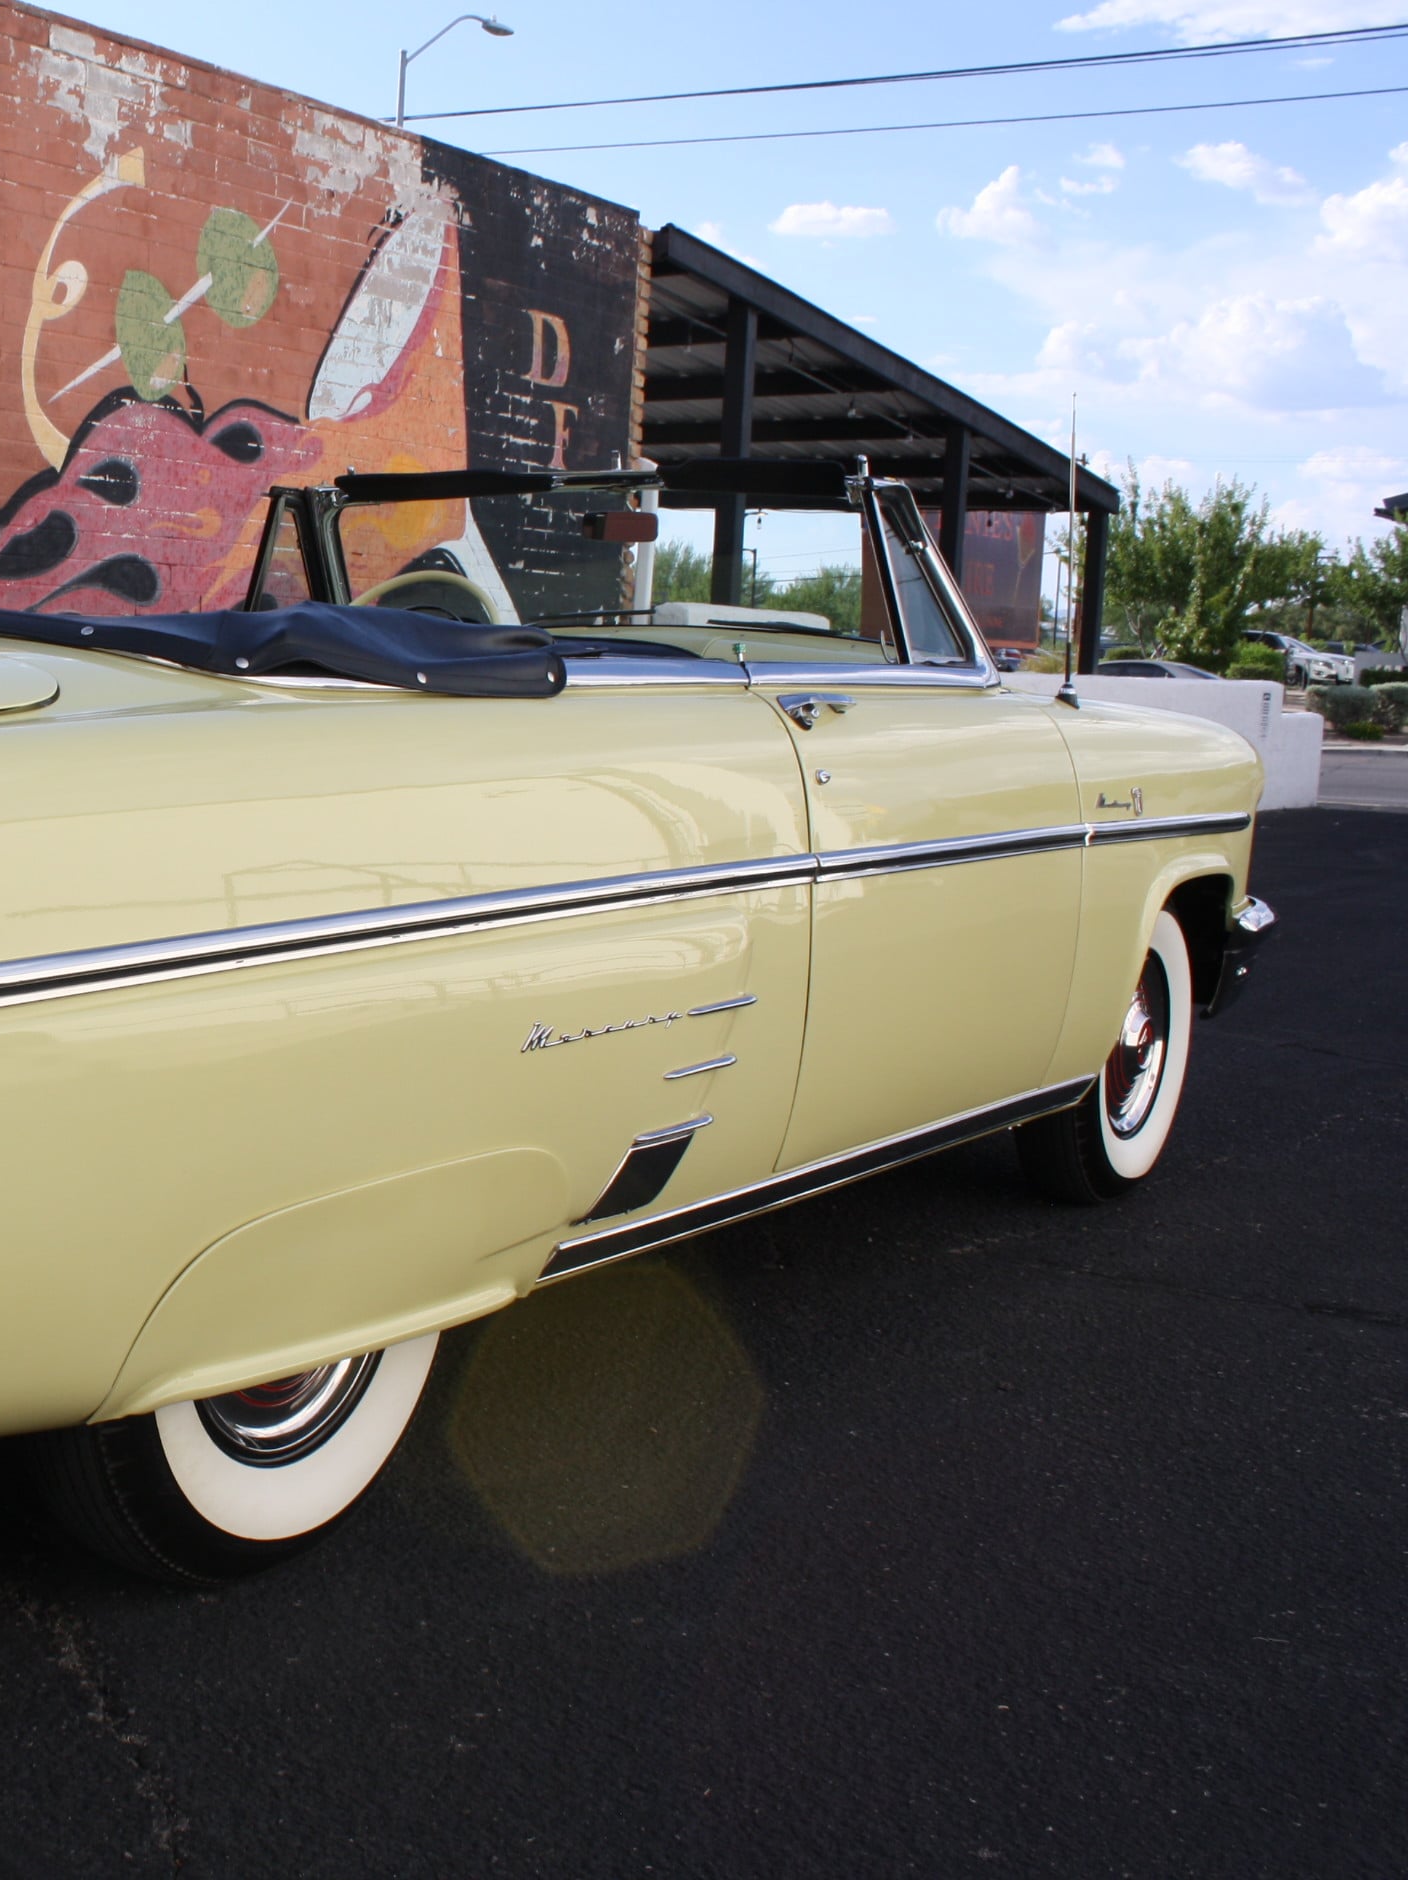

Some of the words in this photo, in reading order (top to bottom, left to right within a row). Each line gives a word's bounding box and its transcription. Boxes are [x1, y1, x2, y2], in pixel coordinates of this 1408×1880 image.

[520, 309, 572, 388] D
[548, 400, 579, 471] F
[520, 1011, 684, 1053] Mercury
